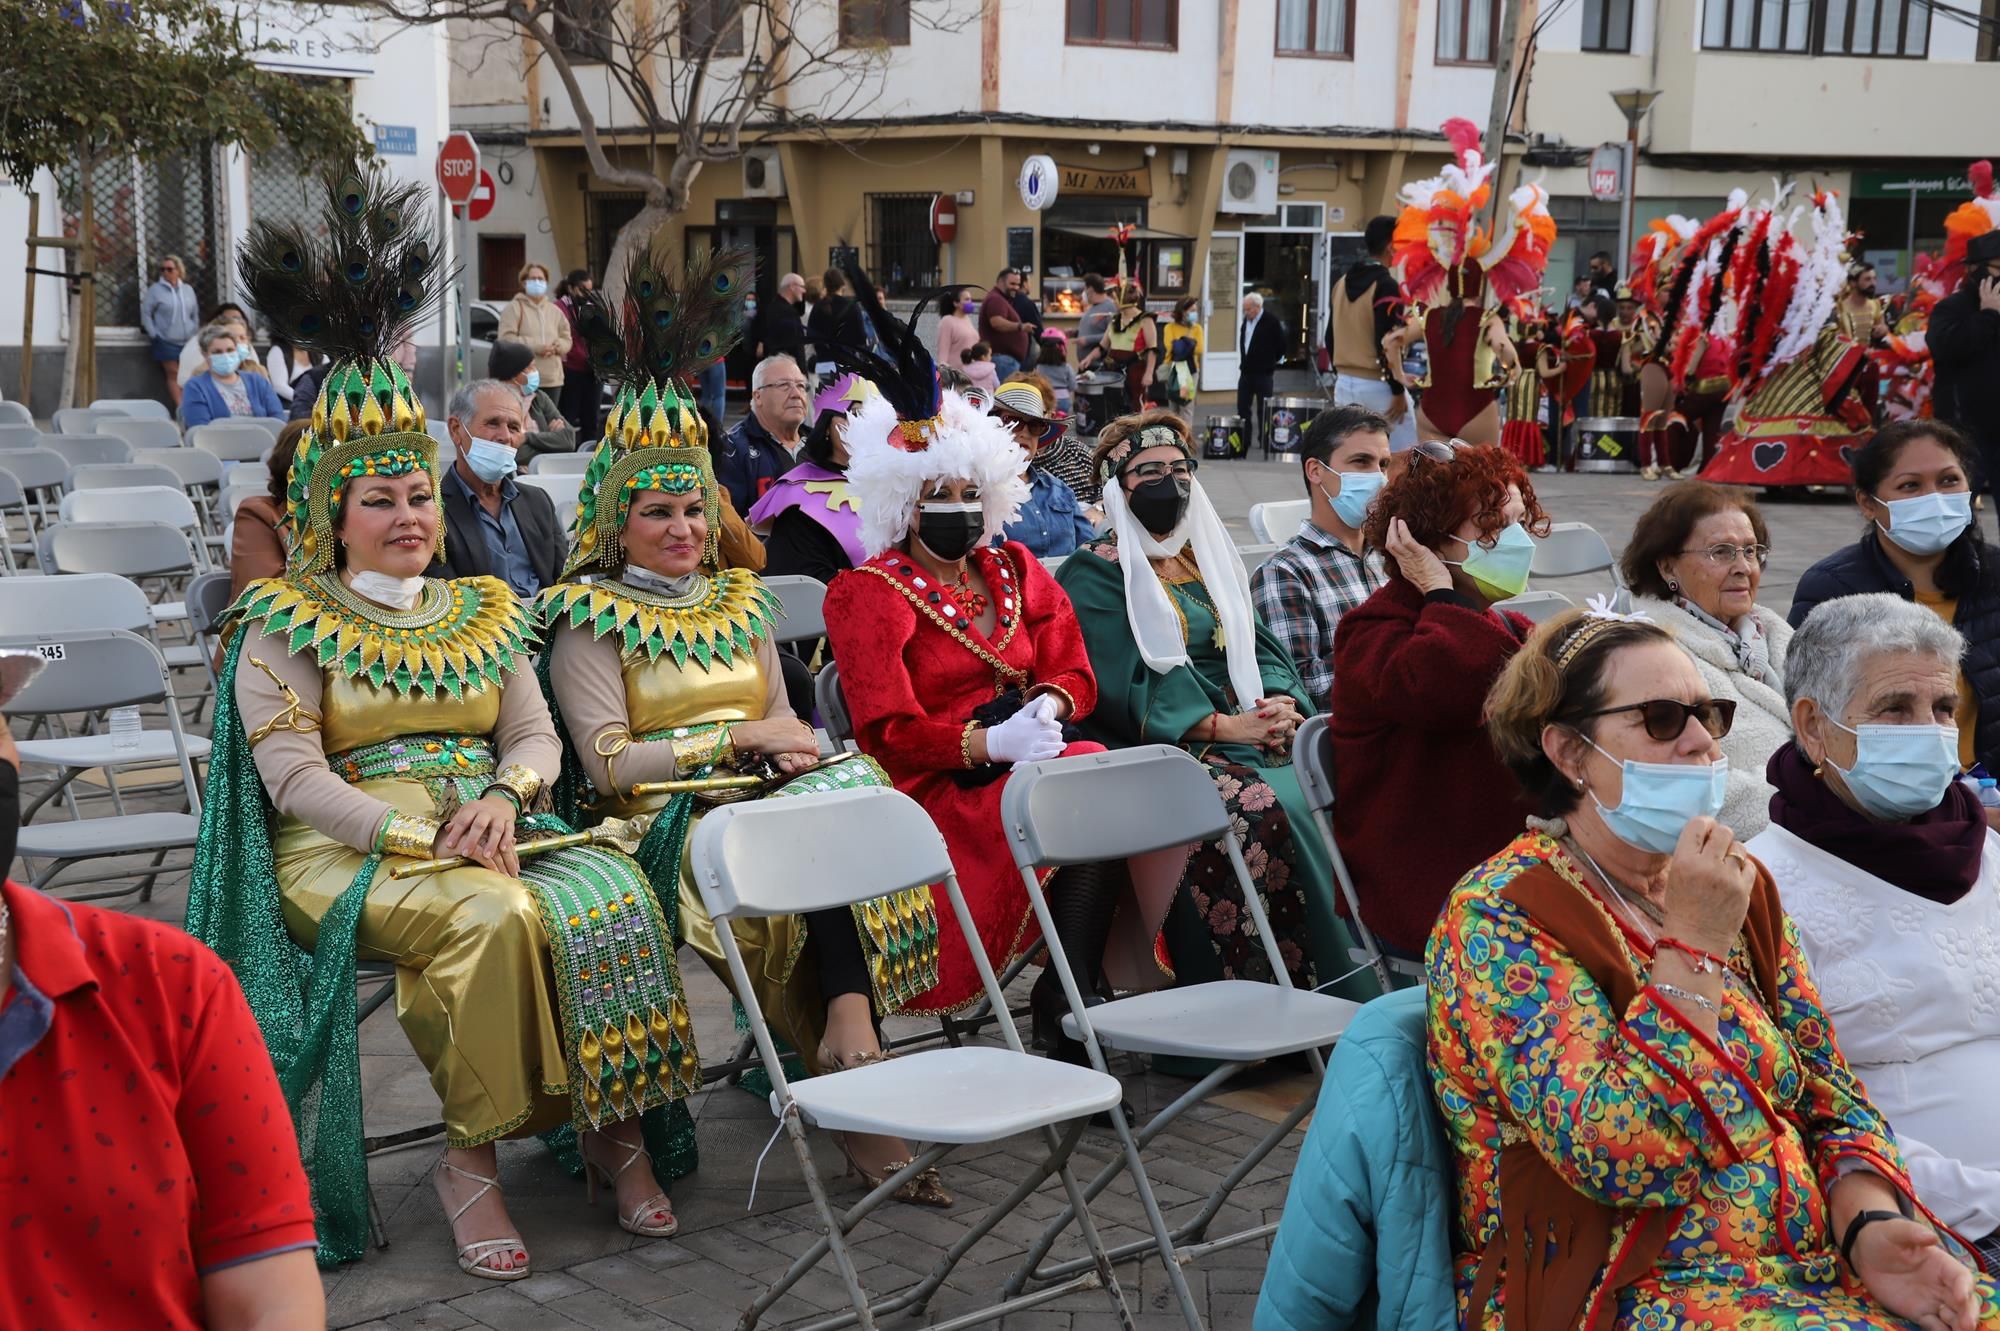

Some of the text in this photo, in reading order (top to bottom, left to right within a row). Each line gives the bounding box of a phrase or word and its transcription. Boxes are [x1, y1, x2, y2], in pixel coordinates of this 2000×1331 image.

[443, 159, 473, 176] STOP
[1065, 171, 1137, 190] MI NIÑA
[40, 645, 63, 659] 345
